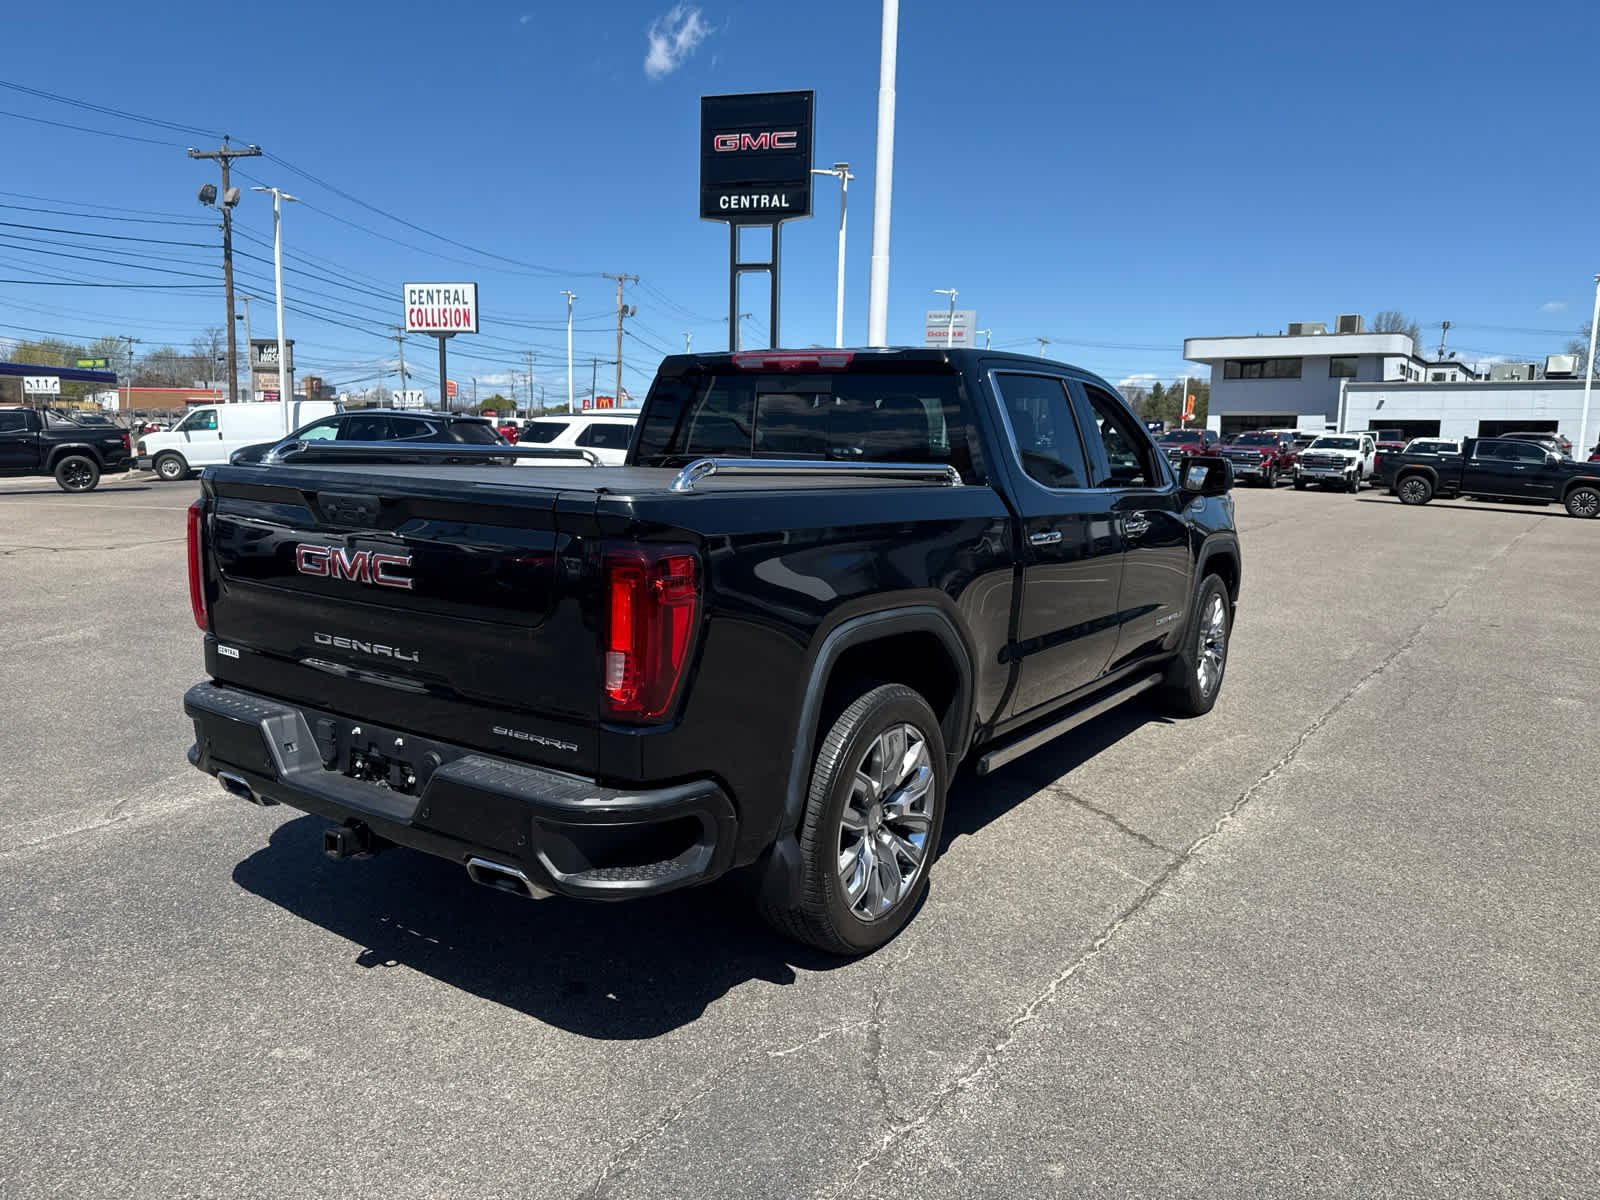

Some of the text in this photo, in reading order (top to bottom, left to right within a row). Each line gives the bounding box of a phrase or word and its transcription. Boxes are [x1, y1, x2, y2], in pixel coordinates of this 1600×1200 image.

[714, 131, 797, 152] GMC
[719, 194, 790, 209] CENTRAL
[409, 289, 469, 305] CENTRAL
[409, 307, 471, 328] COLLISION
[296, 543, 413, 589] GMC
[313, 631, 420, 662] DENALI
[492, 726, 578, 752] SIERRA
